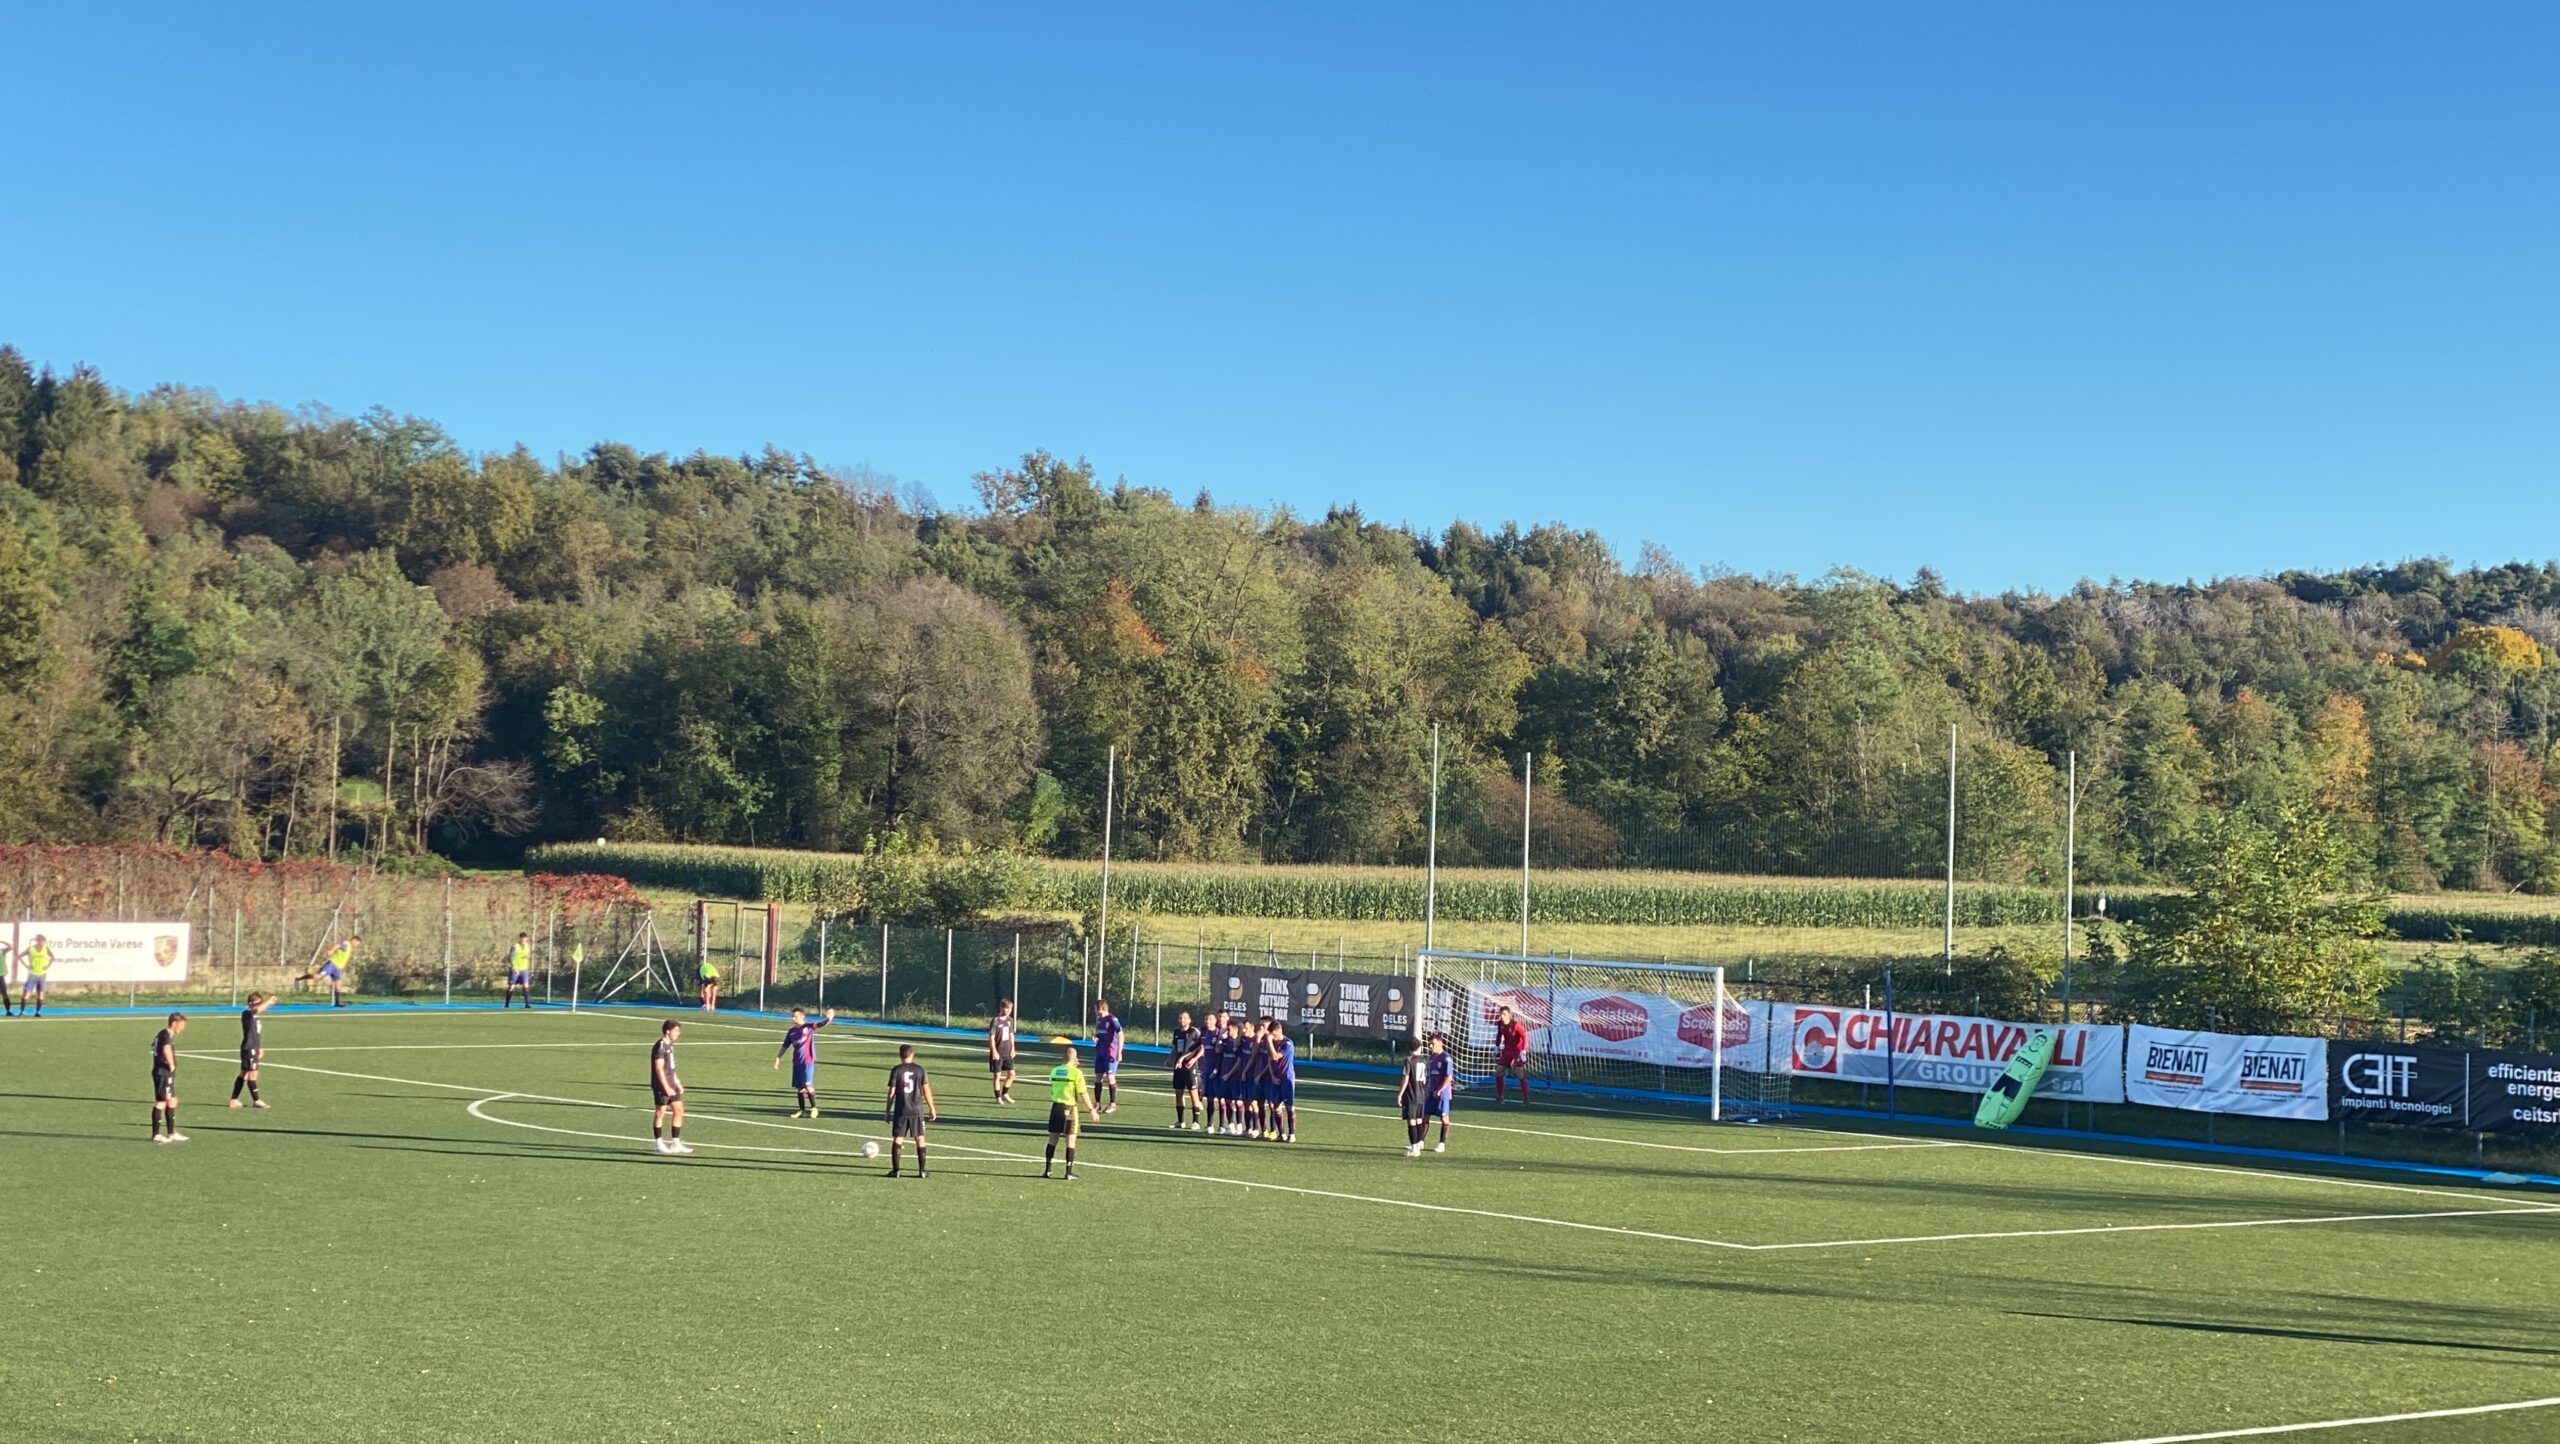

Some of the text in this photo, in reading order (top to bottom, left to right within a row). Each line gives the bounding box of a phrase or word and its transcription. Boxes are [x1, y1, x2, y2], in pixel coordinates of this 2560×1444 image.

[66, 938, 107, 949] Porsche
[110, 938, 143, 949] Varese
[1260, 977, 1289, 996] THINK
[1340, 983, 1370, 1001] THINK
[1223, 1001, 1247, 1012] DELES
[1259, 994, 1289, 1008] OUTSIDE
[1339, 1000, 1370, 1014] OUTSIDE
[1274, 1008, 1288, 1021] BOX
[1301, 1007, 1325, 1018] DELES
[1339, 1012, 1353, 1026] THE
[1354, 1013, 1369, 1027] BOX
[1382, 1013, 1408, 1025] DELES
[1845, 1013, 2087, 1067] CHIARAVALI
[2146, 1046, 2208, 1074] BIENATI
[2241, 1055, 2306, 1081] BIENATI
[904, 1071, 914, 1094] 5
[2342, 1096, 2452, 1115] impianti tecnologici
